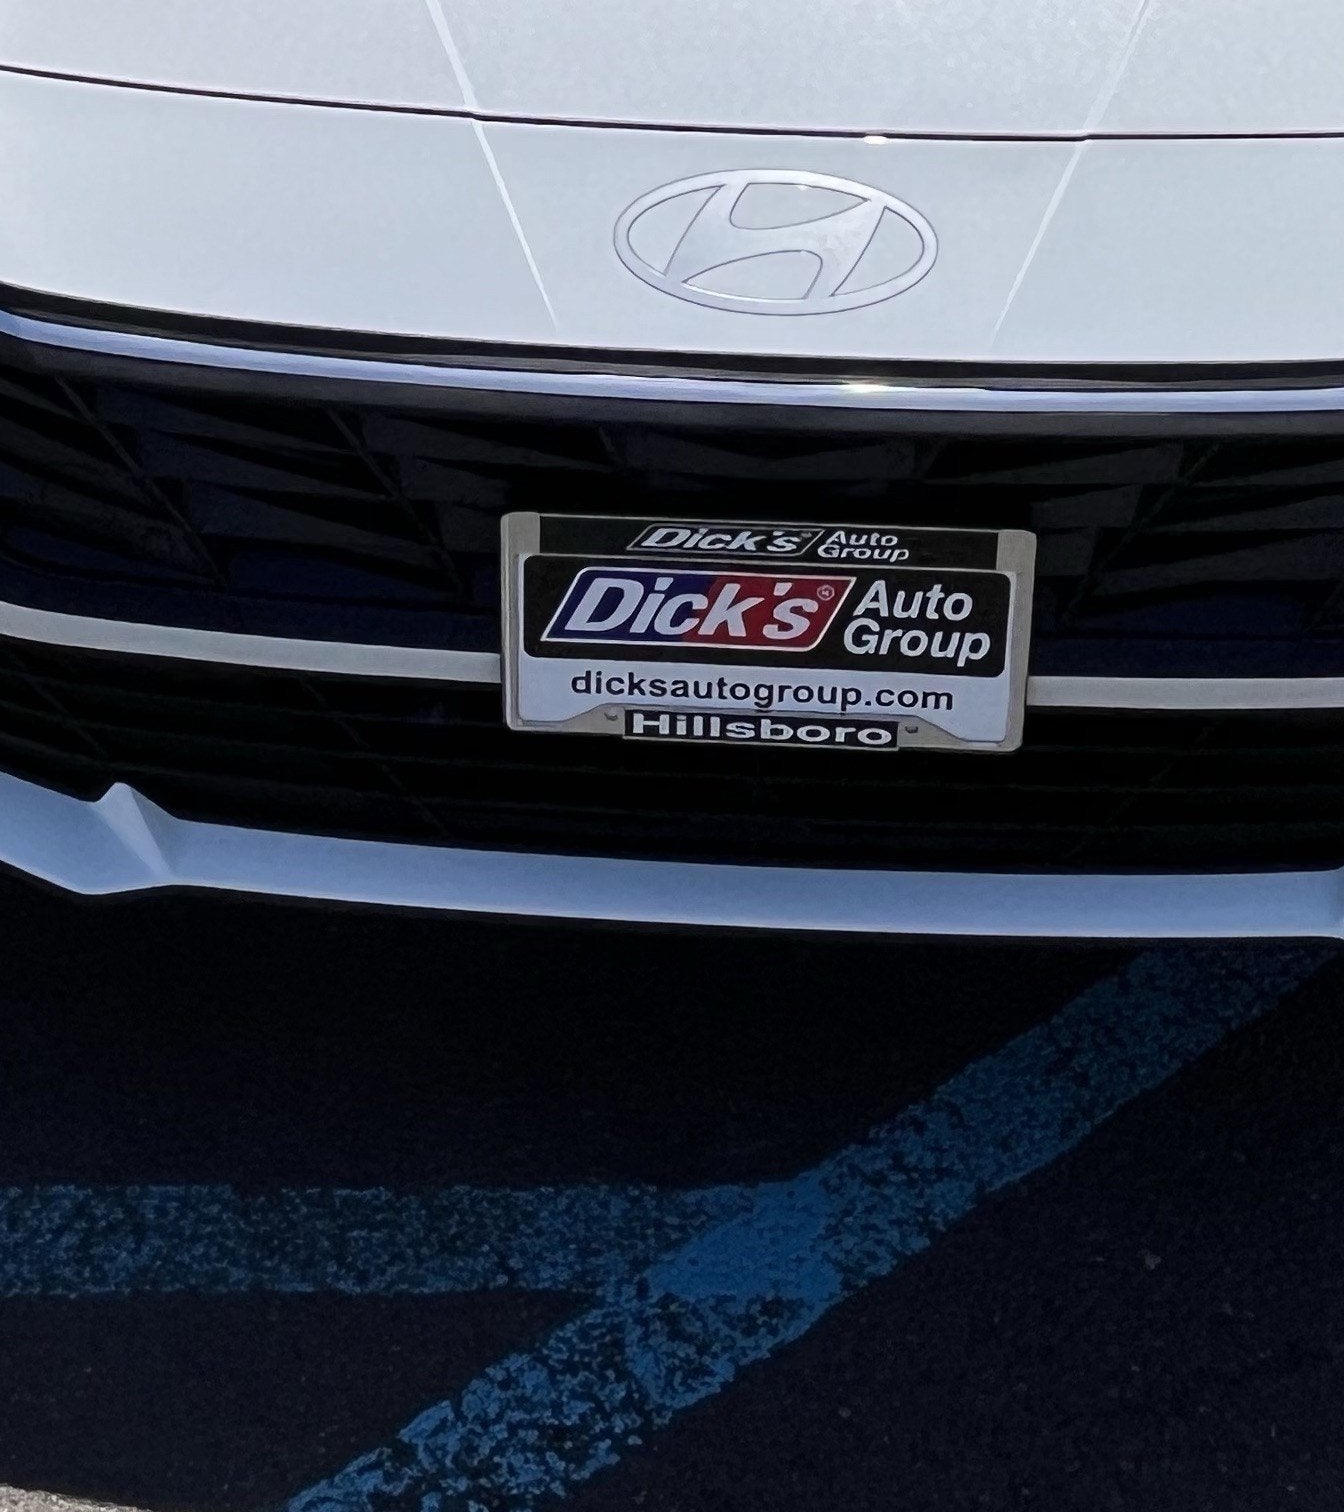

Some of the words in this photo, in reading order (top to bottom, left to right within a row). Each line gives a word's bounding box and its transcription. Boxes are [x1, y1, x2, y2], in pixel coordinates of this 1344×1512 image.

[641, 527, 802, 553] Dick's
[825, 530, 898, 546] Auto
[817, 543, 910, 563] Group
[564, 576, 819, 640] Dick's
[853, 579, 974, 621] Auto
[843, 617, 991, 667] Group
[571, 670, 953, 710] dicksautogroup.com
[632, 713, 892, 746] Hillsboro
